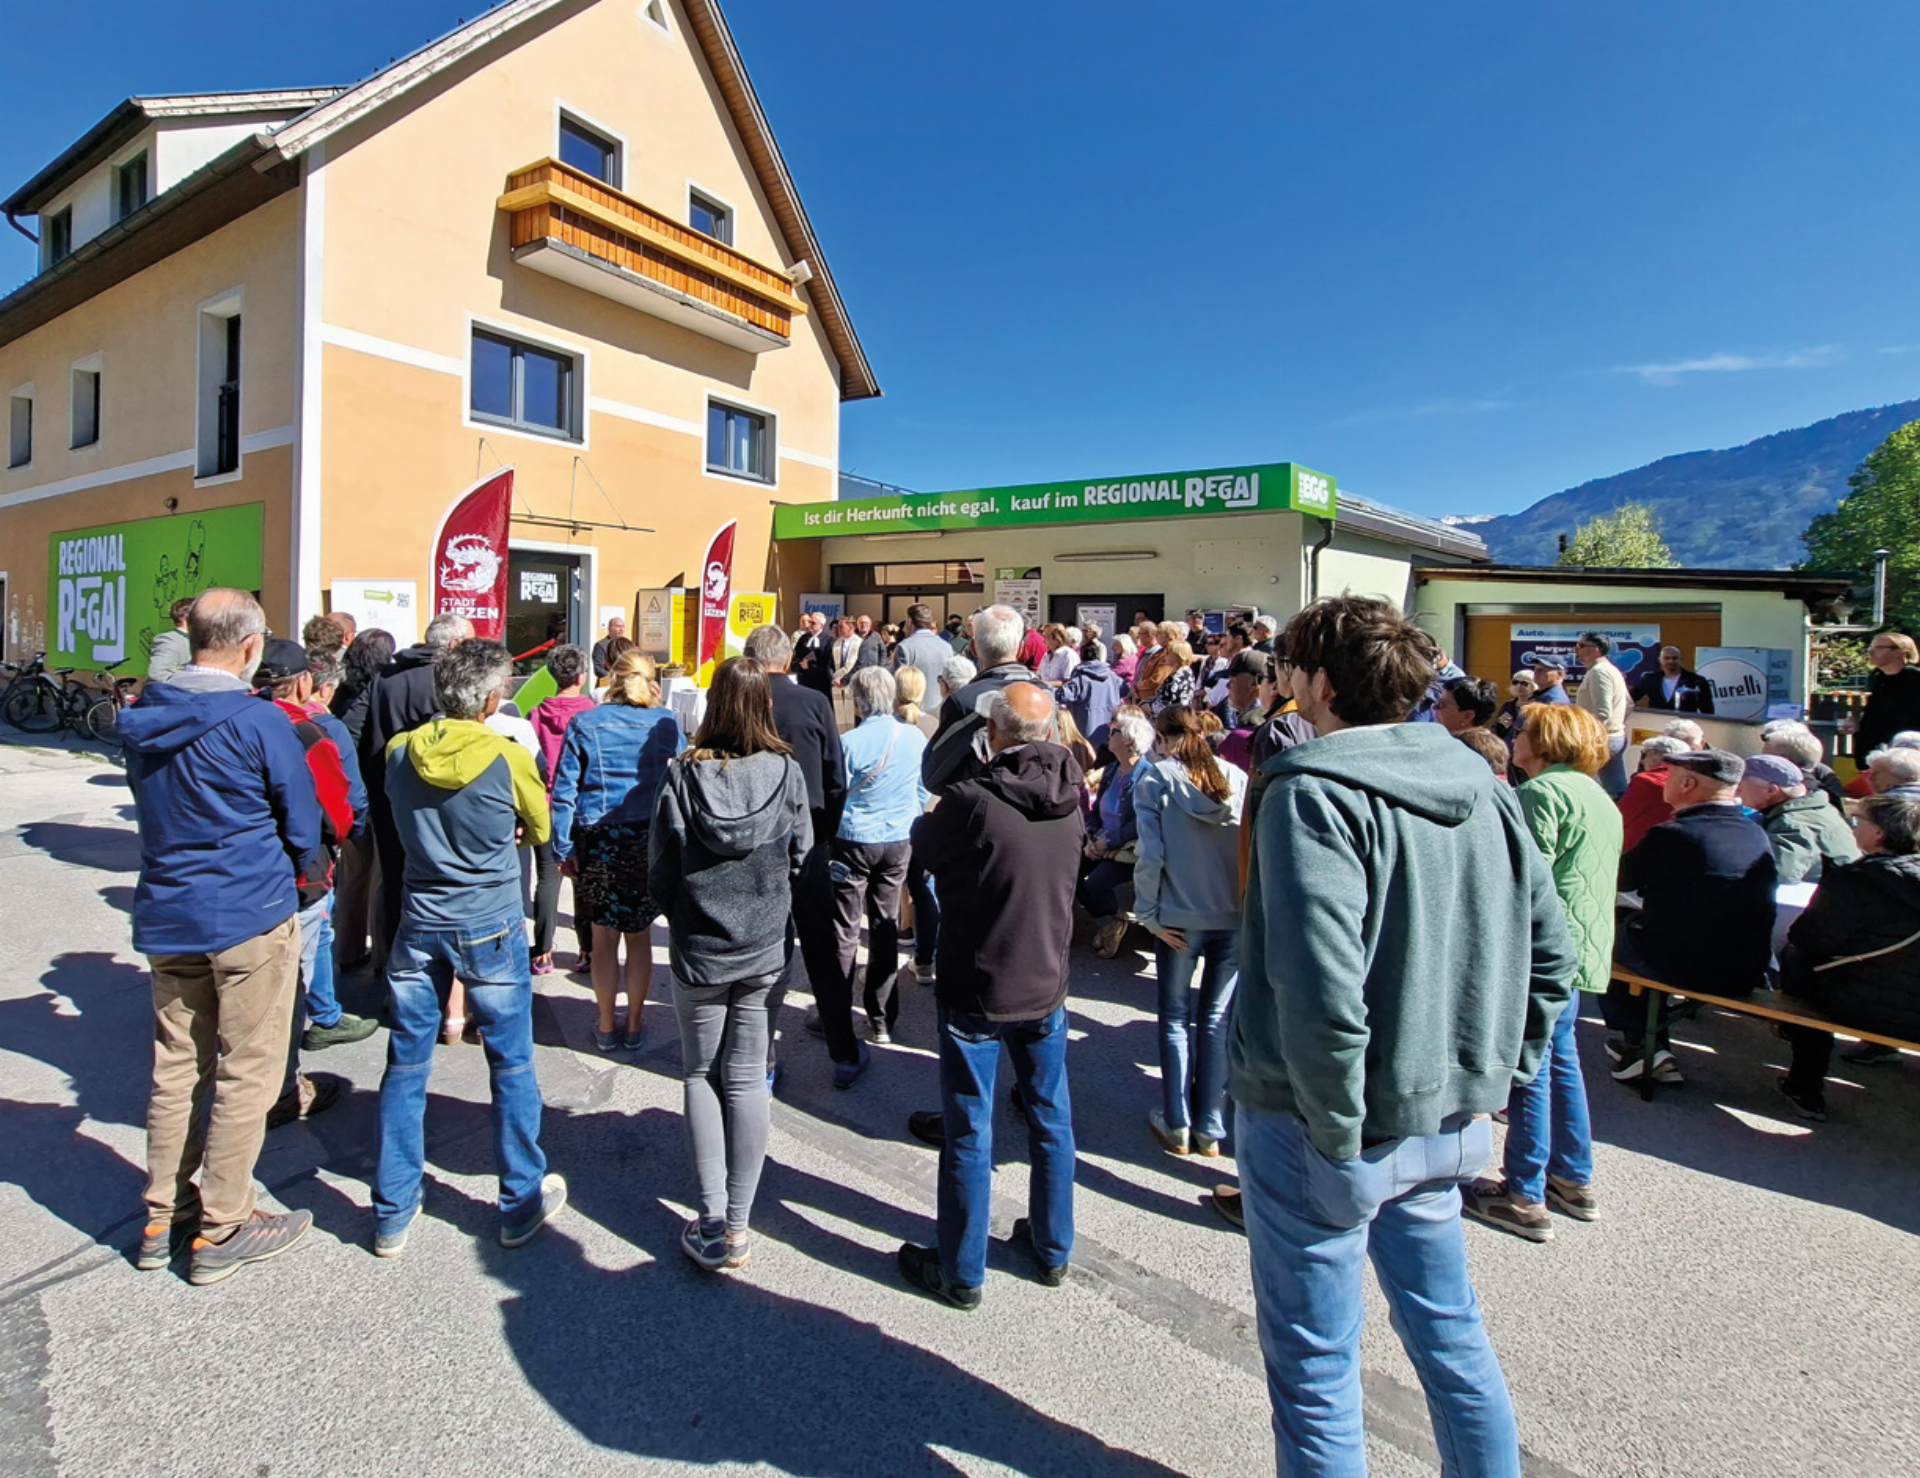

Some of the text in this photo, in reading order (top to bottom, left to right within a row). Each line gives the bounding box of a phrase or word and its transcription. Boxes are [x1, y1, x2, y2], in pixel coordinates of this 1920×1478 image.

[804, 473, 1259, 526] Ist dir Herkunft nicht egal, kauf im REGIONAL REGAL
[58, 533, 126, 575] REGIONAL
[521, 571, 558, 583] REGIONAL
[57, 575, 126, 662] REGAL
[440, 597, 477, 607] STADT
